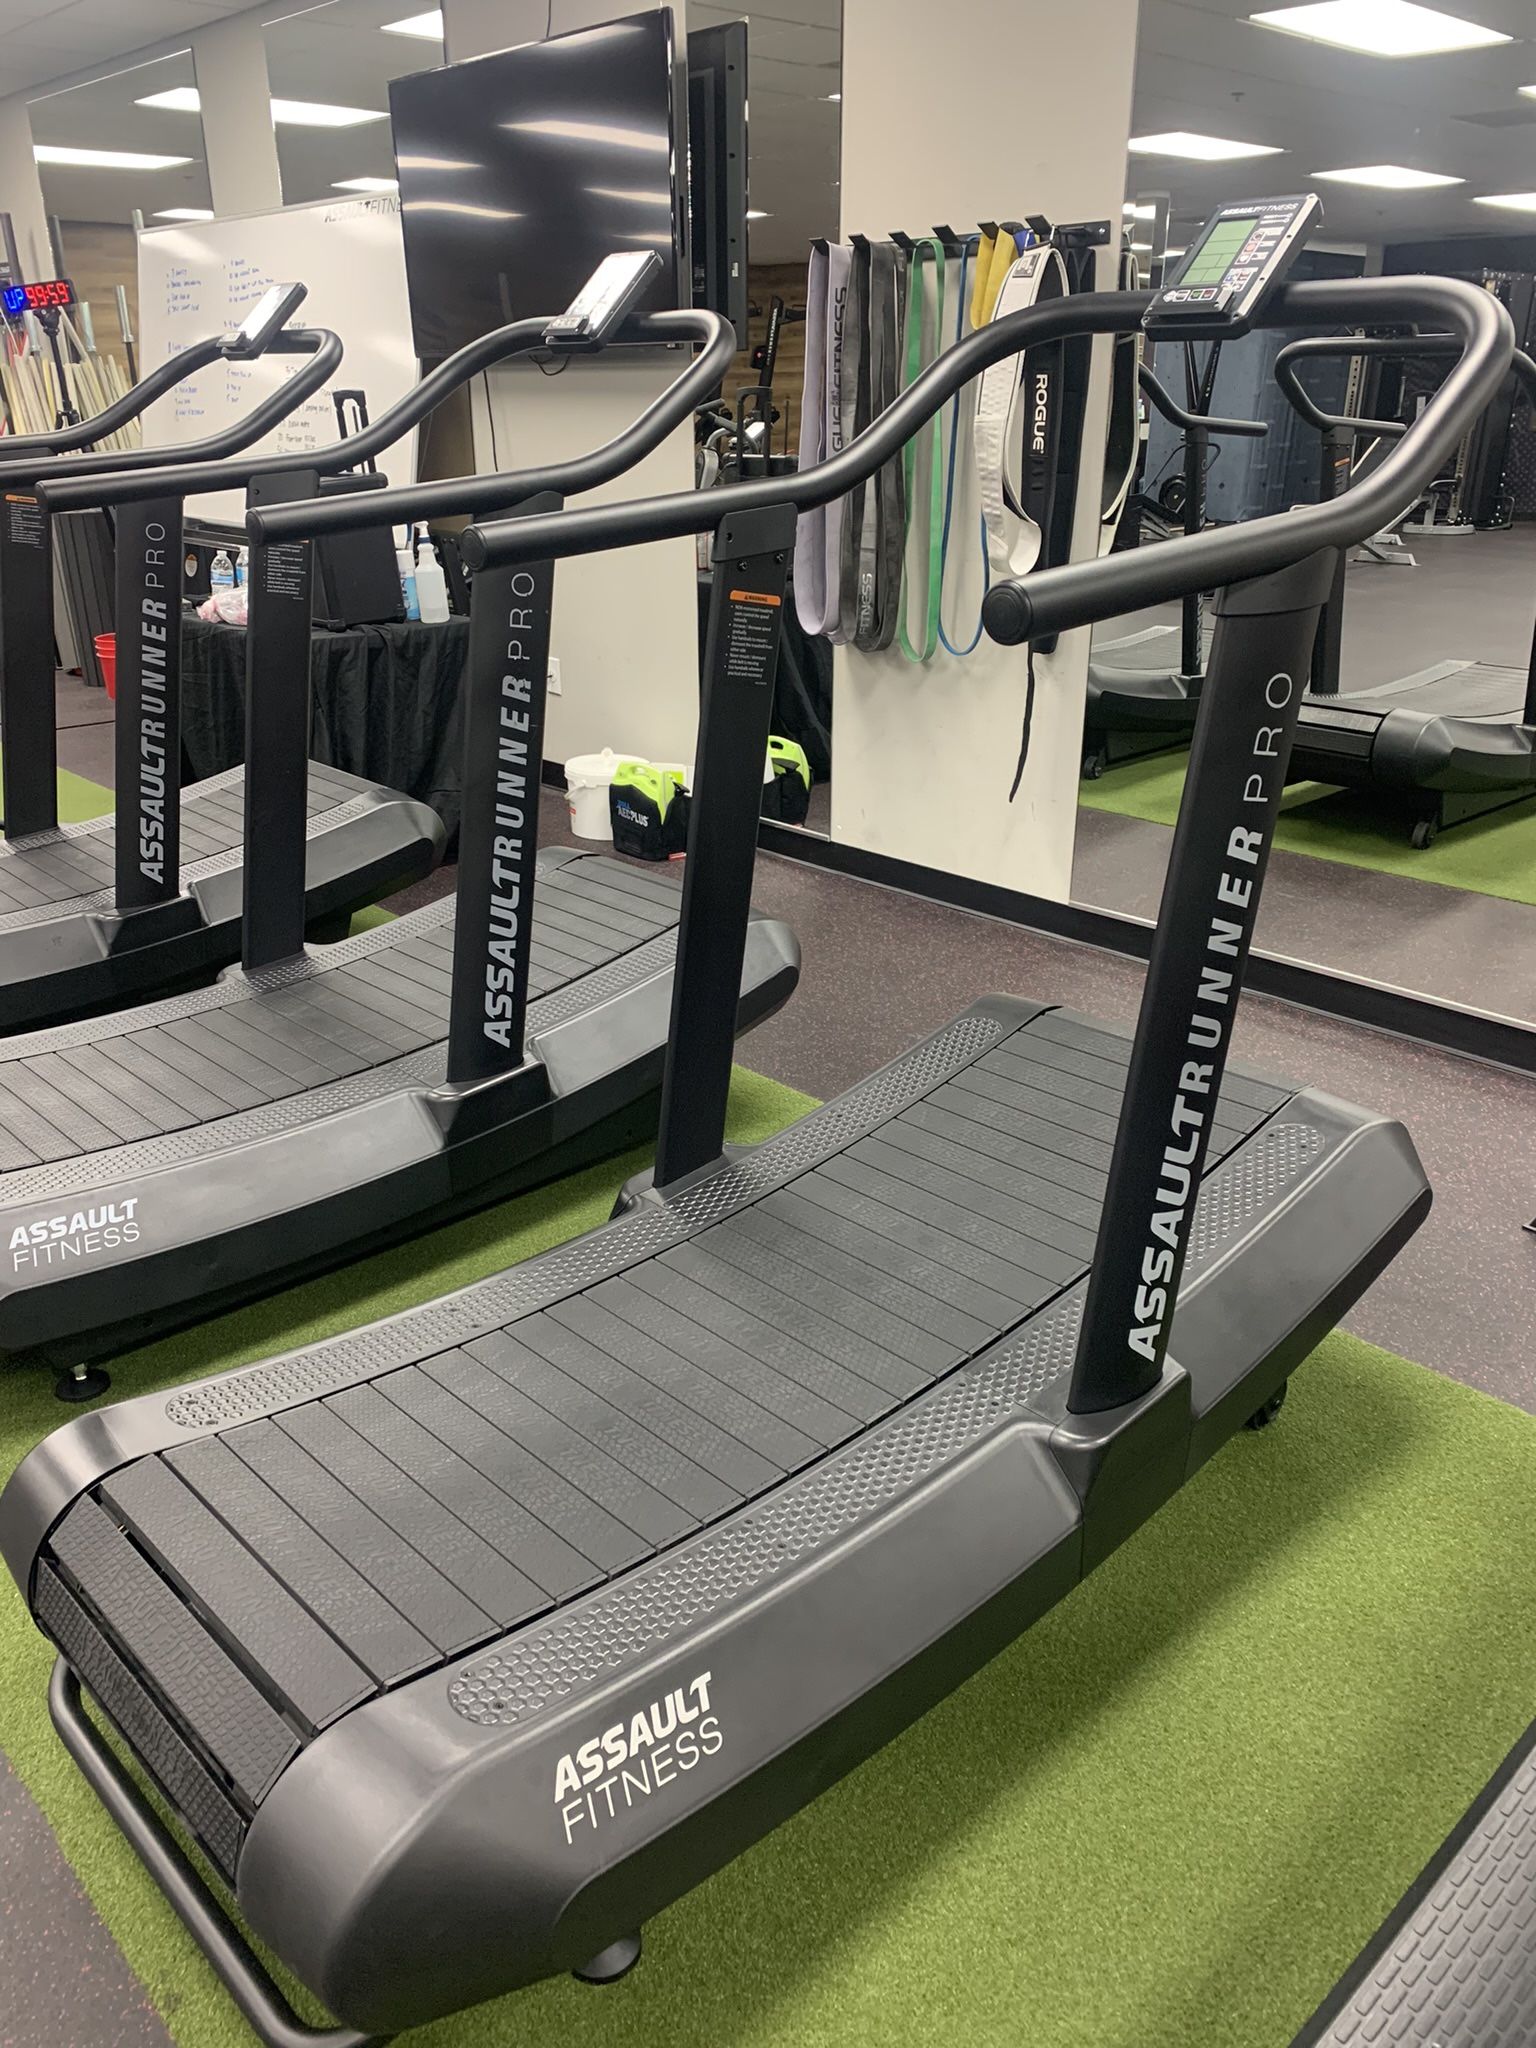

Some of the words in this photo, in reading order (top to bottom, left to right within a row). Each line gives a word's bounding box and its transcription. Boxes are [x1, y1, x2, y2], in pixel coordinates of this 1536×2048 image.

[3, 287, 25, 310] UP
[25, 282, 70, 308] 99:59
[1032, 374, 1048, 450] ROGUE
[145, 522, 166, 588] PRO
[507, 572, 535, 661] PRO
[859, 572, 873, 635] FITNESS
[139, 597, 168, 885] ASSAULTRUNNER
[483, 674, 532, 1049] ASSAULTRUNNER
[1127, 823, 1264, 1363] ASSAULTRUNNER
[1243, 672, 1293, 803] PRO
[8, 1197, 138, 1250] ASSAULT
[13, 1221, 140, 1273] FITNESS
[553, 1670, 712, 1804] ASSAULT
[561, 1716, 723, 1845] FITNESS
